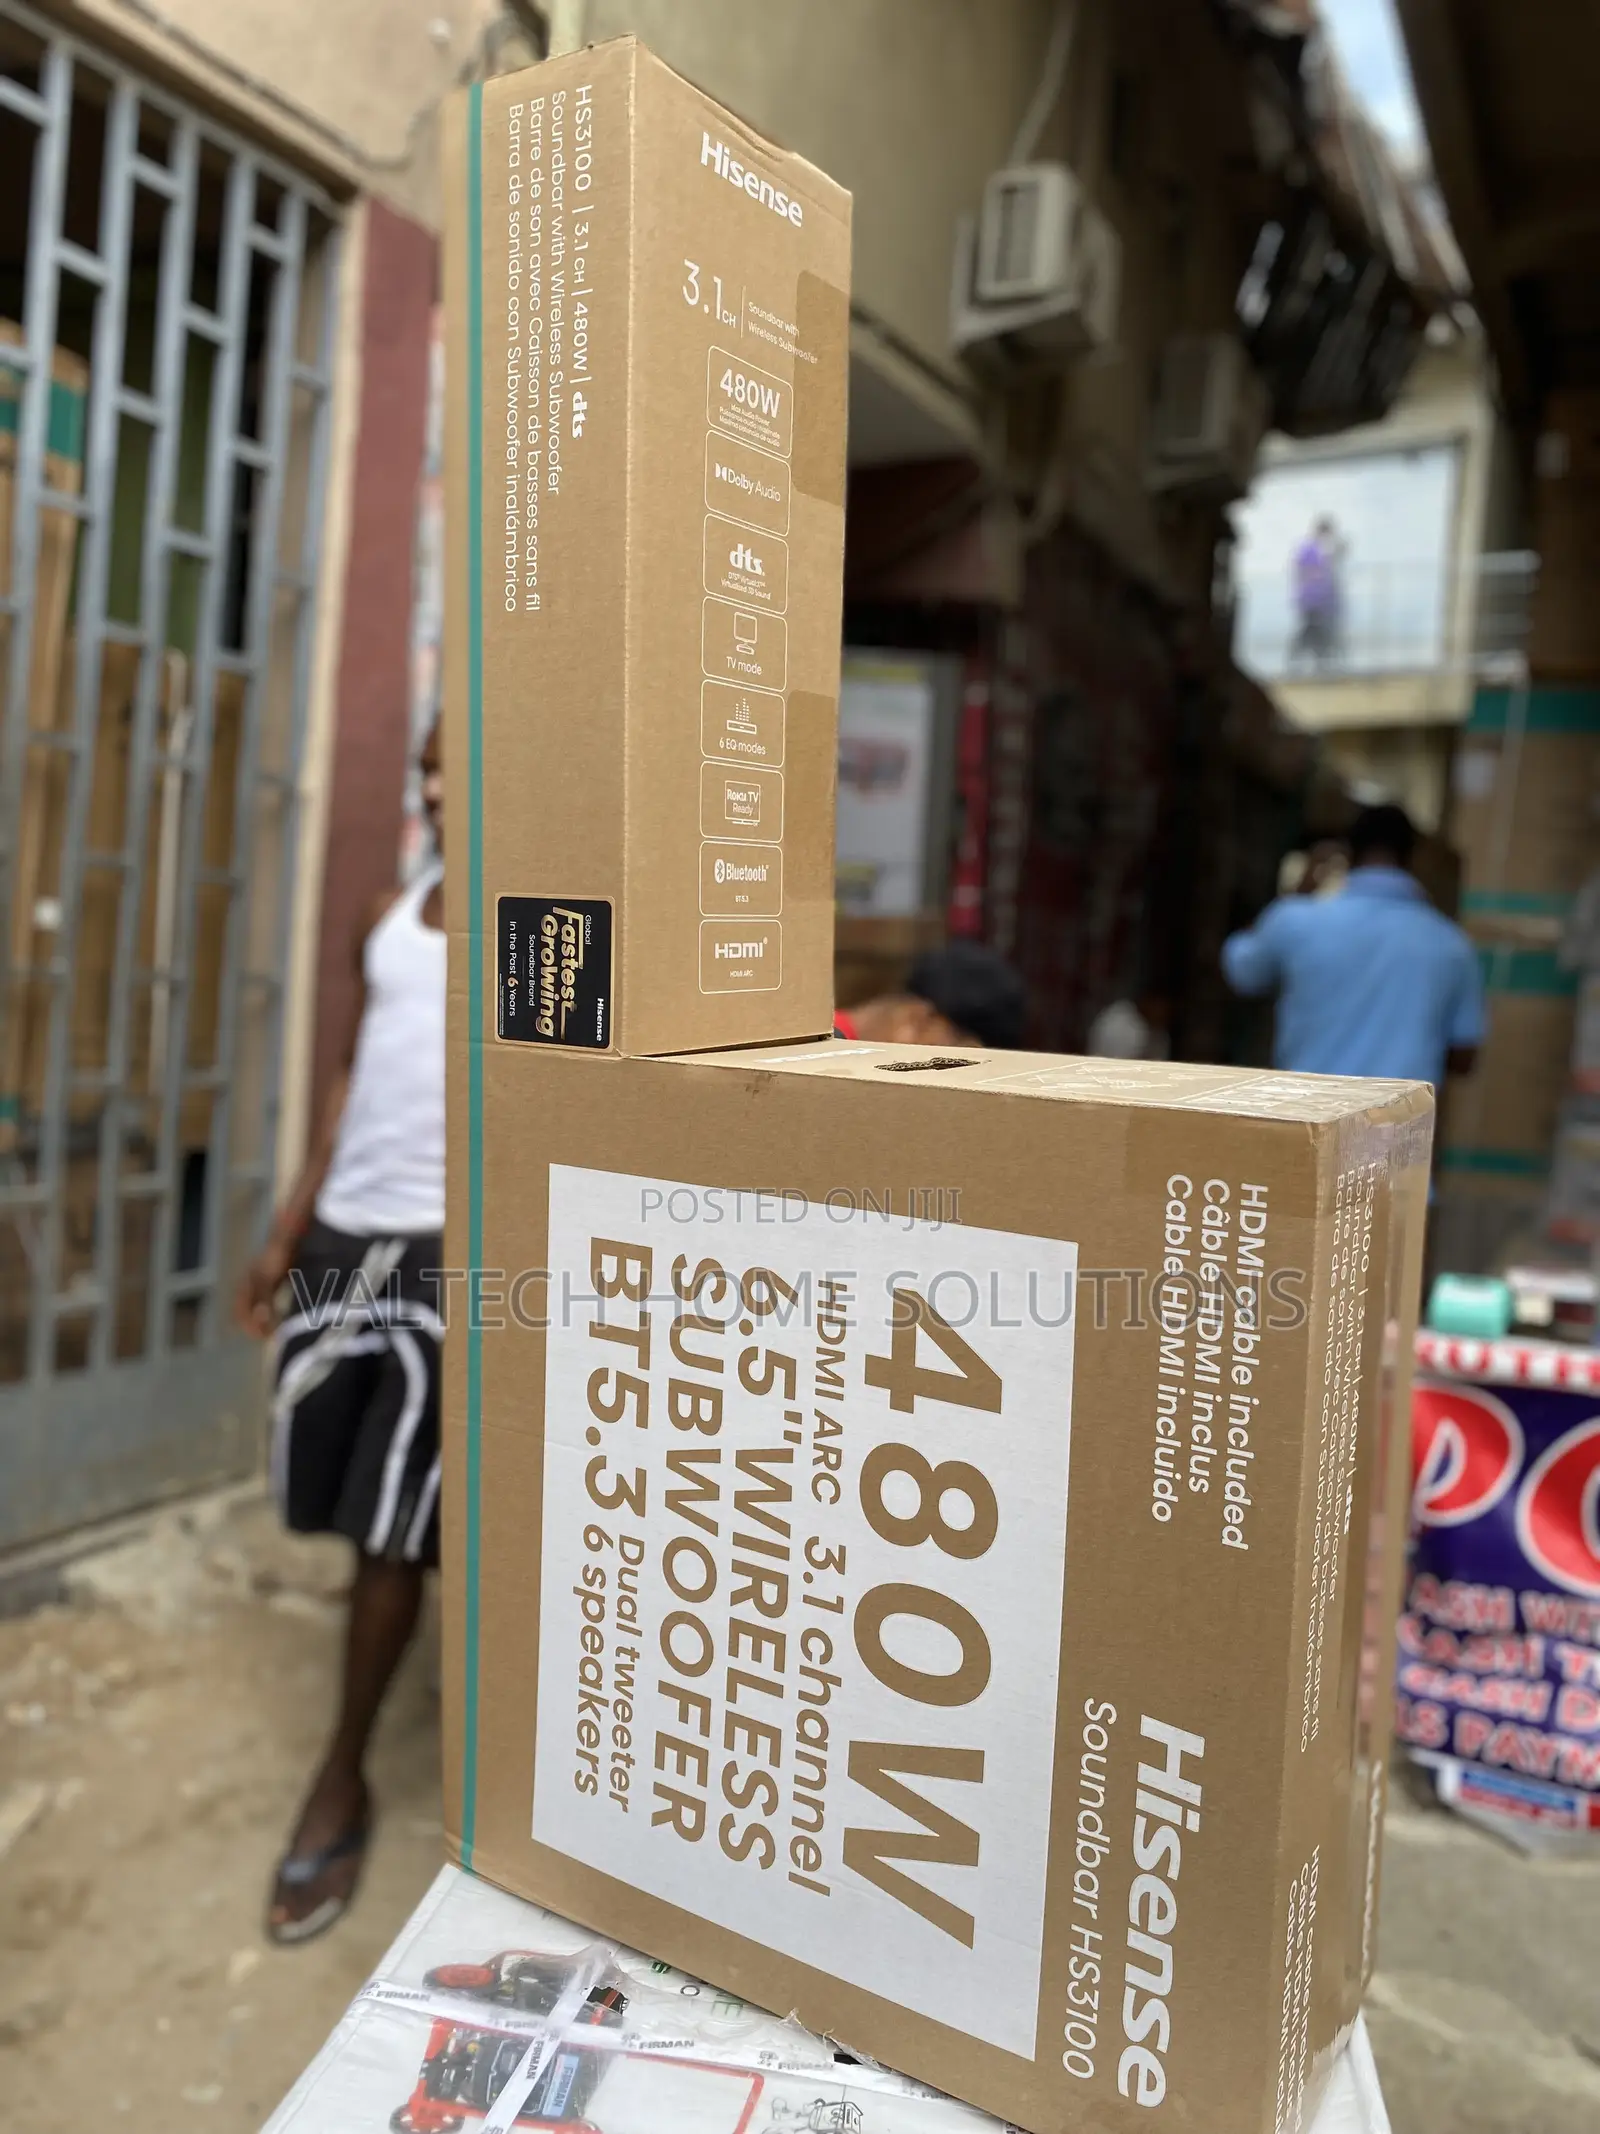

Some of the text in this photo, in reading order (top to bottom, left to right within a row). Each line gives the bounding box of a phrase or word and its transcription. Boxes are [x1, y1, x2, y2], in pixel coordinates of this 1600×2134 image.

[700, 131, 803, 228] Hisense
[548, 90, 566, 495] Soundbar with Wireless Subwoofer
[572, 84, 592, 438] HS3100 3.1 CH 480W dts
[505, 103, 524, 612] Barra de sonido con Subwoofer inalámbrico
[526, 97, 545, 611] Barre de son avec Caisson de basses sans fil
[748, 301, 800, 337] Soundbar with
[748, 321, 818, 364] Wireless Subwoofer
[719, 368, 780, 419] 480W
[728, 468, 781, 502] Dolby Audio
[726, 656, 762, 675] TV mode
[719, 737, 766, 755] 6 EQ modes
[732, 803, 753, 816] Ready
[748, 791, 759, 803] TV
[507, 921, 519, 1017] In the Past 6 Years
[528, 934, 536, 1006] Soundbar Brand
[552, 906, 584, 1040] Fastest
[596, 998, 604, 1041] Hisense
[1361, 1162, 1376, 1273] HS3100
[584, 1236, 653, 1518] BT5.3
[1151, 1173, 1193, 1524] Cable HDMI incluido
[1188, 1178, 1231, 1494] Câble HDMI inclus
[1222, 1182, 1269, 1550] HDMI cable included
[1329, 1165, 1365, 1602] Soundbar with Wireless Subwoofer
[1300, 1174, 1345, 1752] Barra de sonido con Subwoofer inalámbrico
[1310, 1170, 1355, 1741] Barre de son avec Caisson de basses sans fil
[1348, 1390, 1359, 1461] 480W
[651, 1253, 727, 1843] SUBWOOFER
[788, 1279, 848, 1897] HDMI ARC 3.1 channel
[573, 1523, 614, 1797] 6 speakers
[842, 1286, 1003, 1950] 480W
[608, 1534, 645, 1813] Dual tweeter
[1061, 1697, 1117, 2081] Soundbar HS3100
[1116, 1714, 1206, 2109] Hisense
[1285, 1879, 1297, 1968] Cable
[1307, 1844, 1320, 1923] HDMI
[376, 1989, 431, 2002] FIRMAN
[1280, 1969, 1293, 2051] HDMI
[1291, 1952, 1303, 2031] HDMI
[1302, 1927, 1314, 2007] cable
[639, 2040, 695, 2050] FIRMAN
[1286, 2028, 1299, 2119] inclus
